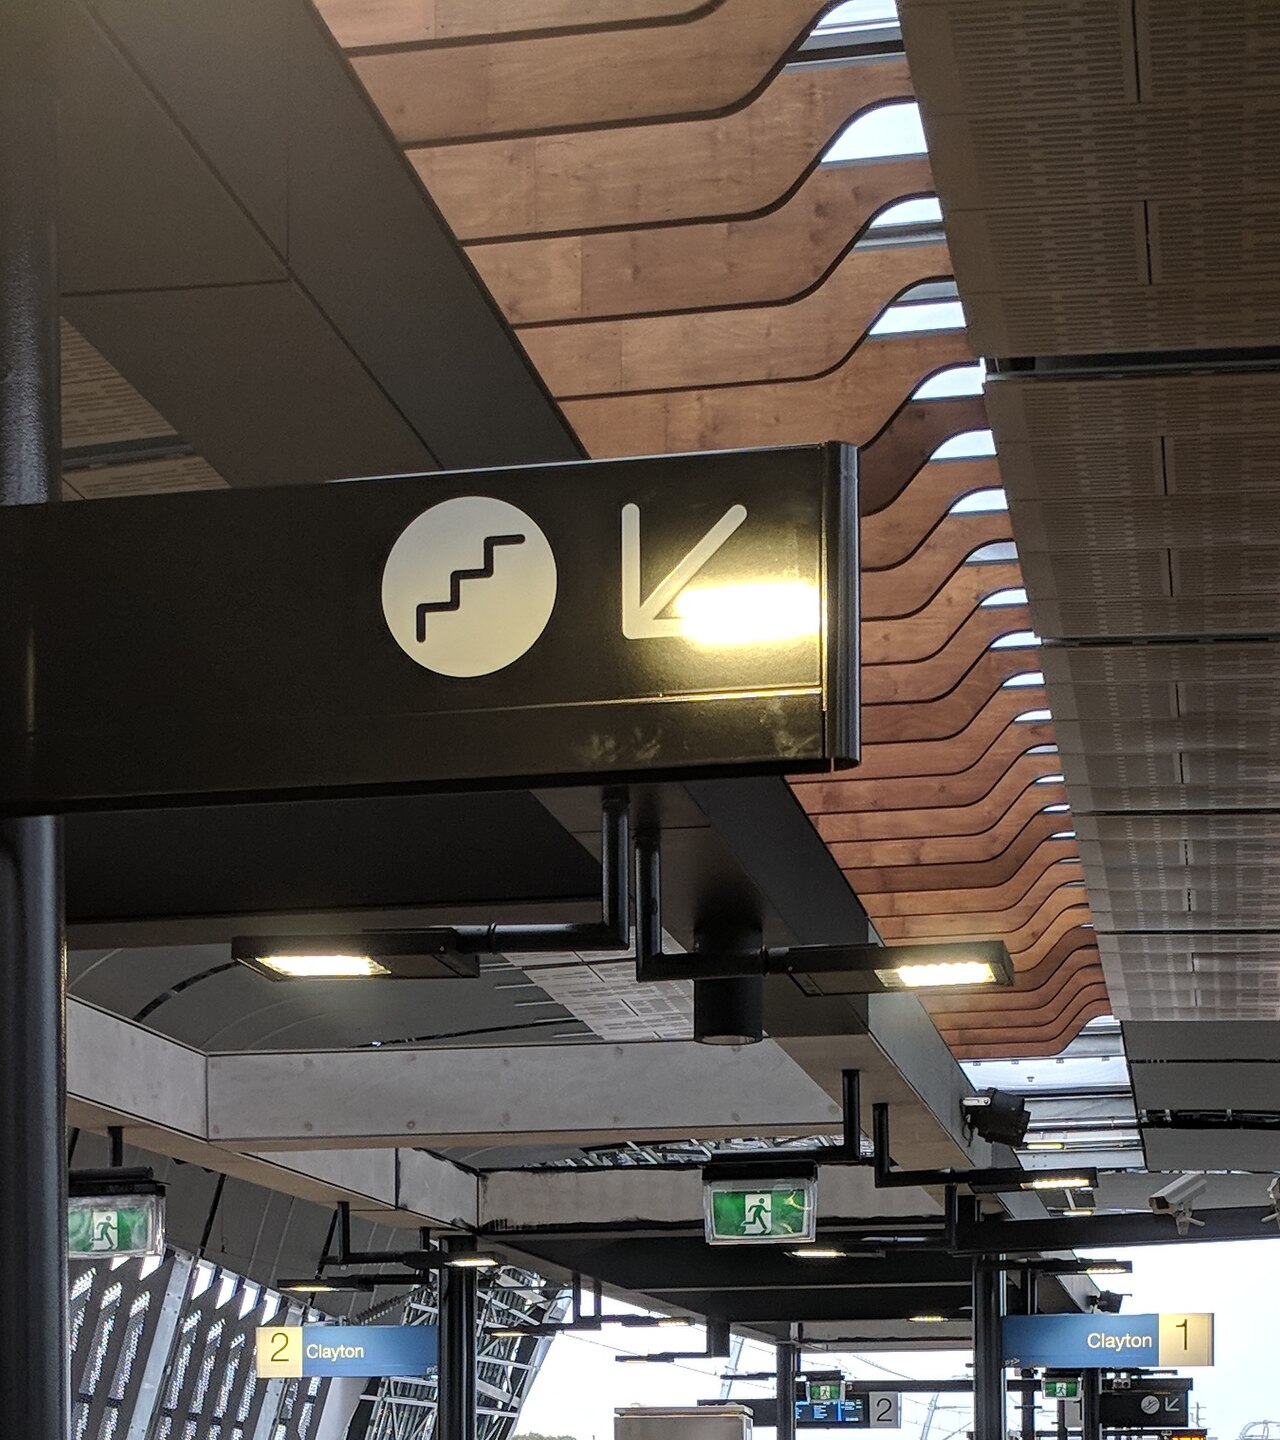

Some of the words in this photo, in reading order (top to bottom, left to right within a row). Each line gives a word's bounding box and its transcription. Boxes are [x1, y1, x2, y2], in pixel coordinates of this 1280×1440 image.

[270, 1332, 290, 1362] 2
[306, 1344, 365, 1362] Clayton
[1087, 1333, 1152, 1352] Clayton
[1175, 1318, 1188, 1351] 1
[876, 1397, 893, 1422] 2
